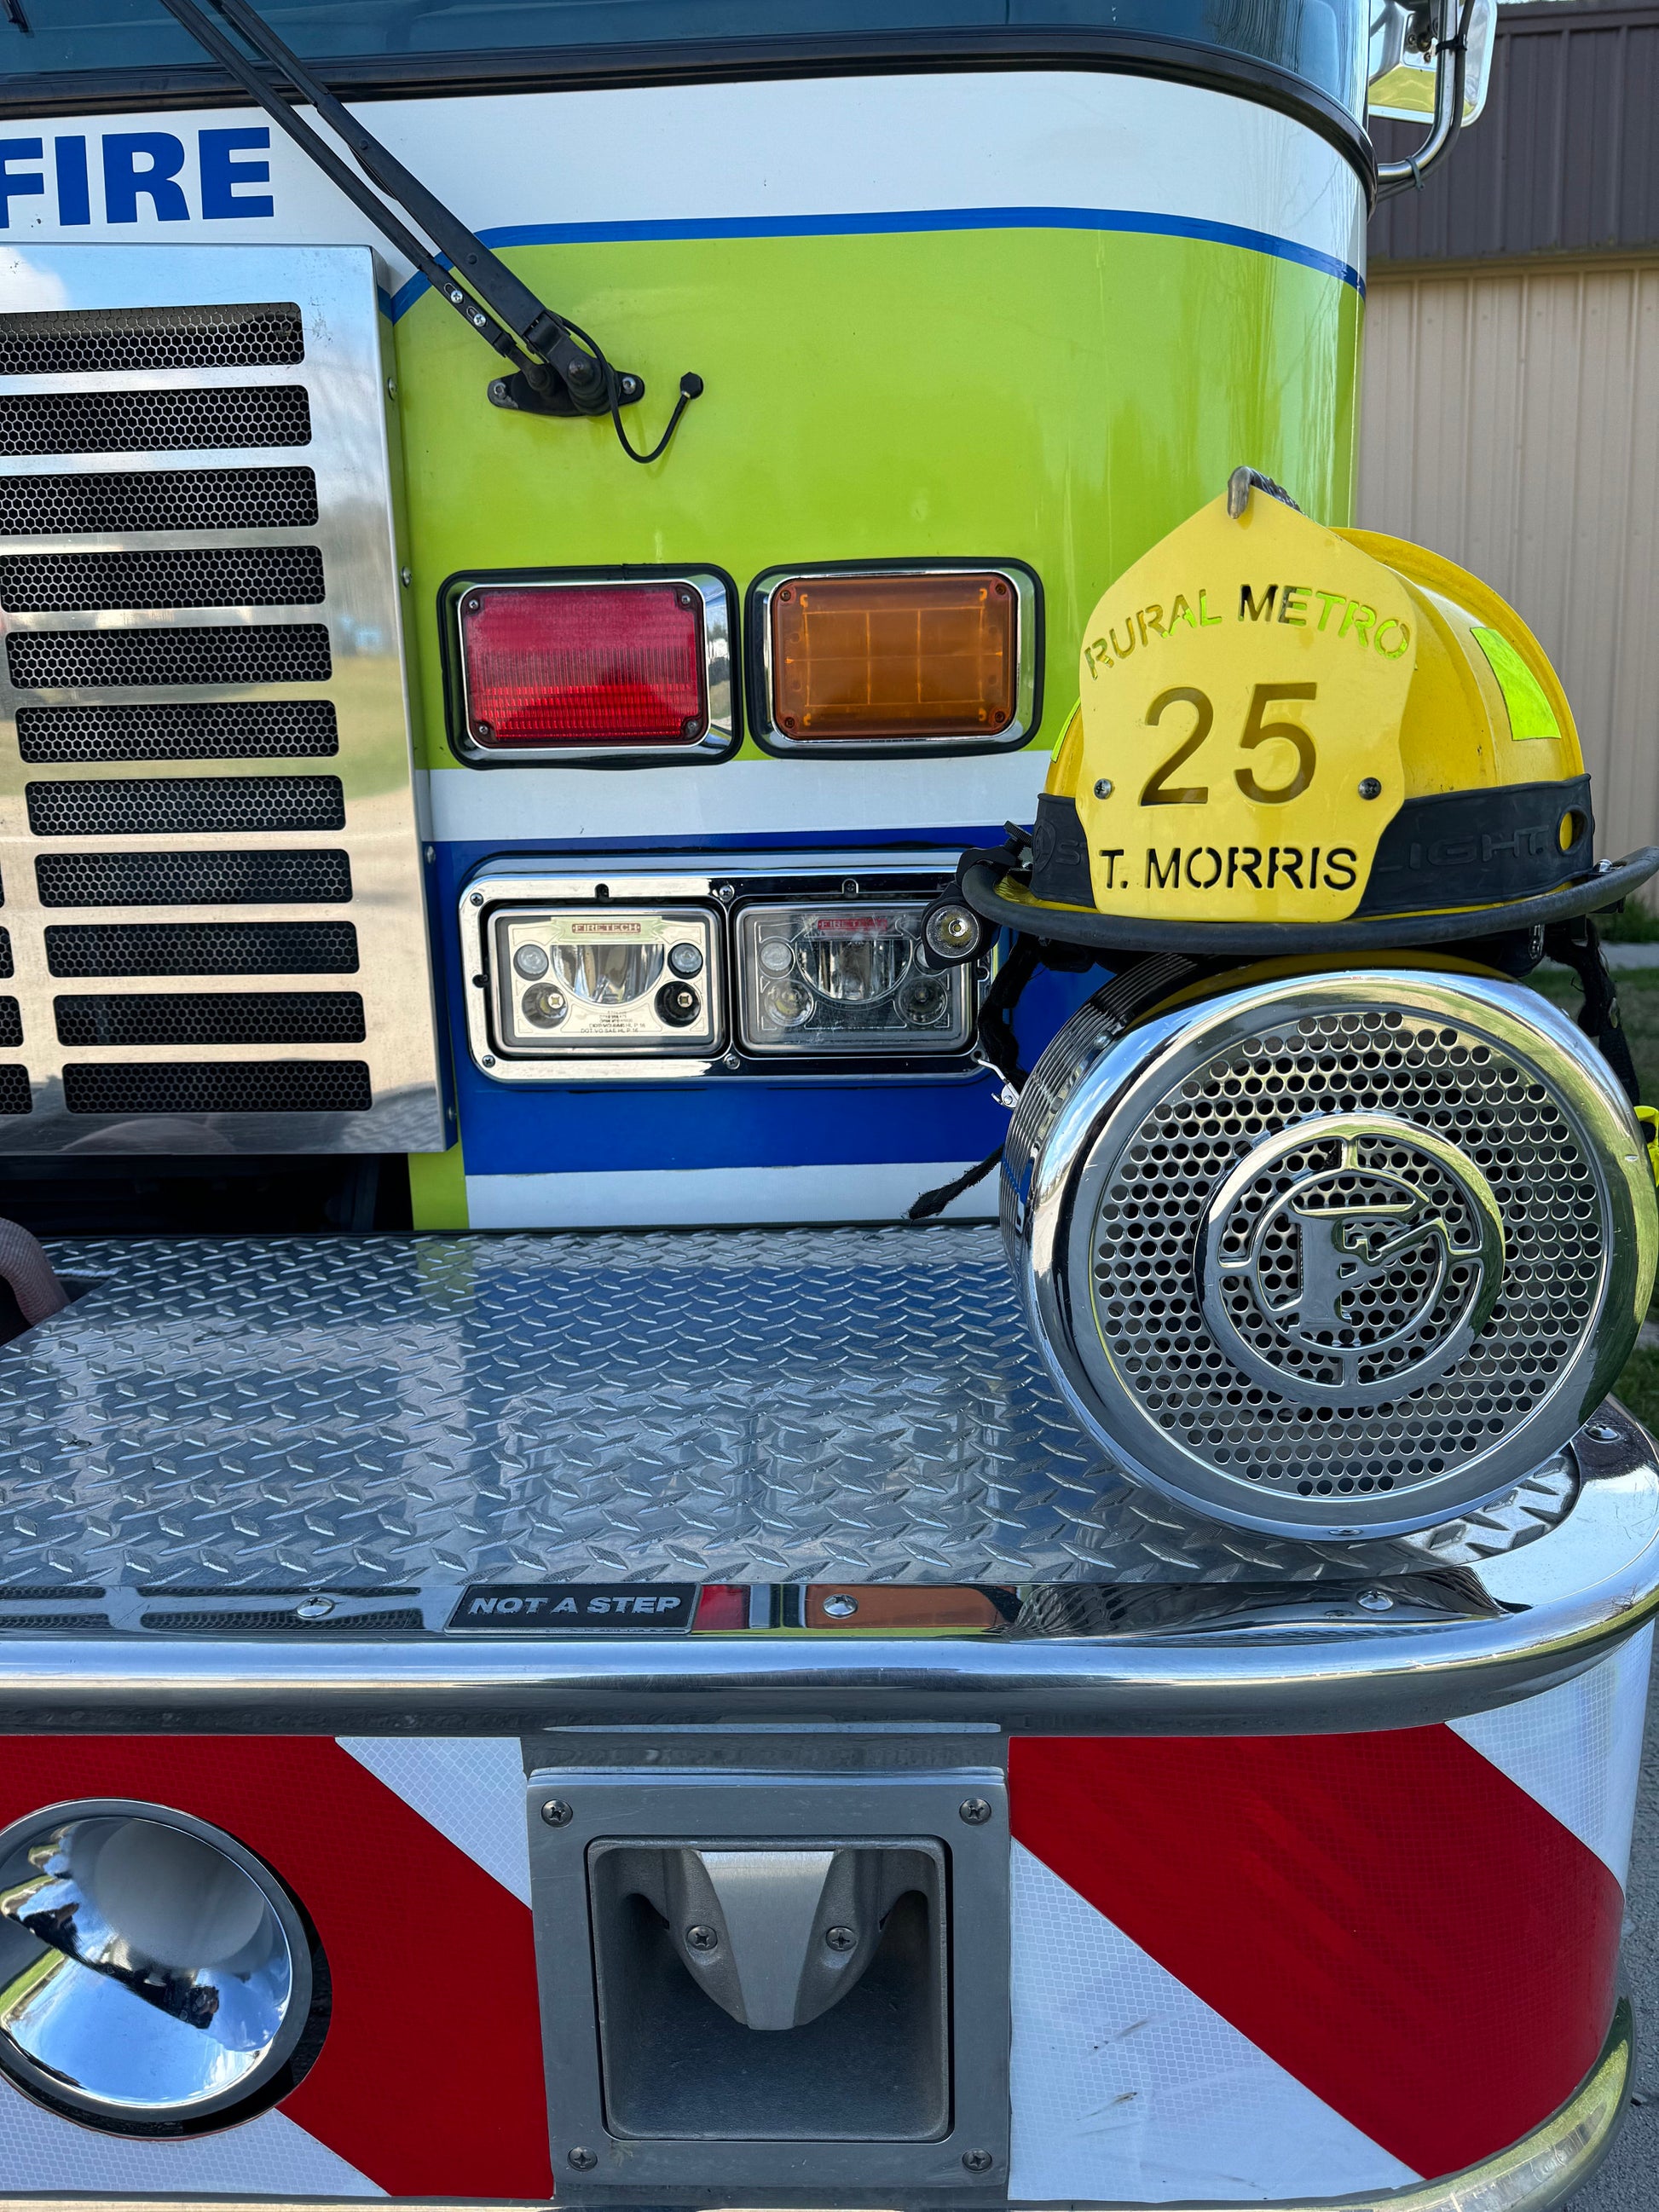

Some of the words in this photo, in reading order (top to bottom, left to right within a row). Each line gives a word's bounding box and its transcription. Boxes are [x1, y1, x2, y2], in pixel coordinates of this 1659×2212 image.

[0, 126, 275, 229] FIRE
[1084, 588, 1223, 680] RURAL
[1238, 583, 1410, 661] METRO
[1138, 682, 1318, 806] 25
[1099, 848, 1129, 889] T.
[1145, 846, 1357, 891] MORRIS
[575, 923, 638, 932] FIRETECH
[468, 1597, 549, 1614] NOT
[550, 1597, 578, 1614] A
[587, 1597, 681, 1614] STEP
